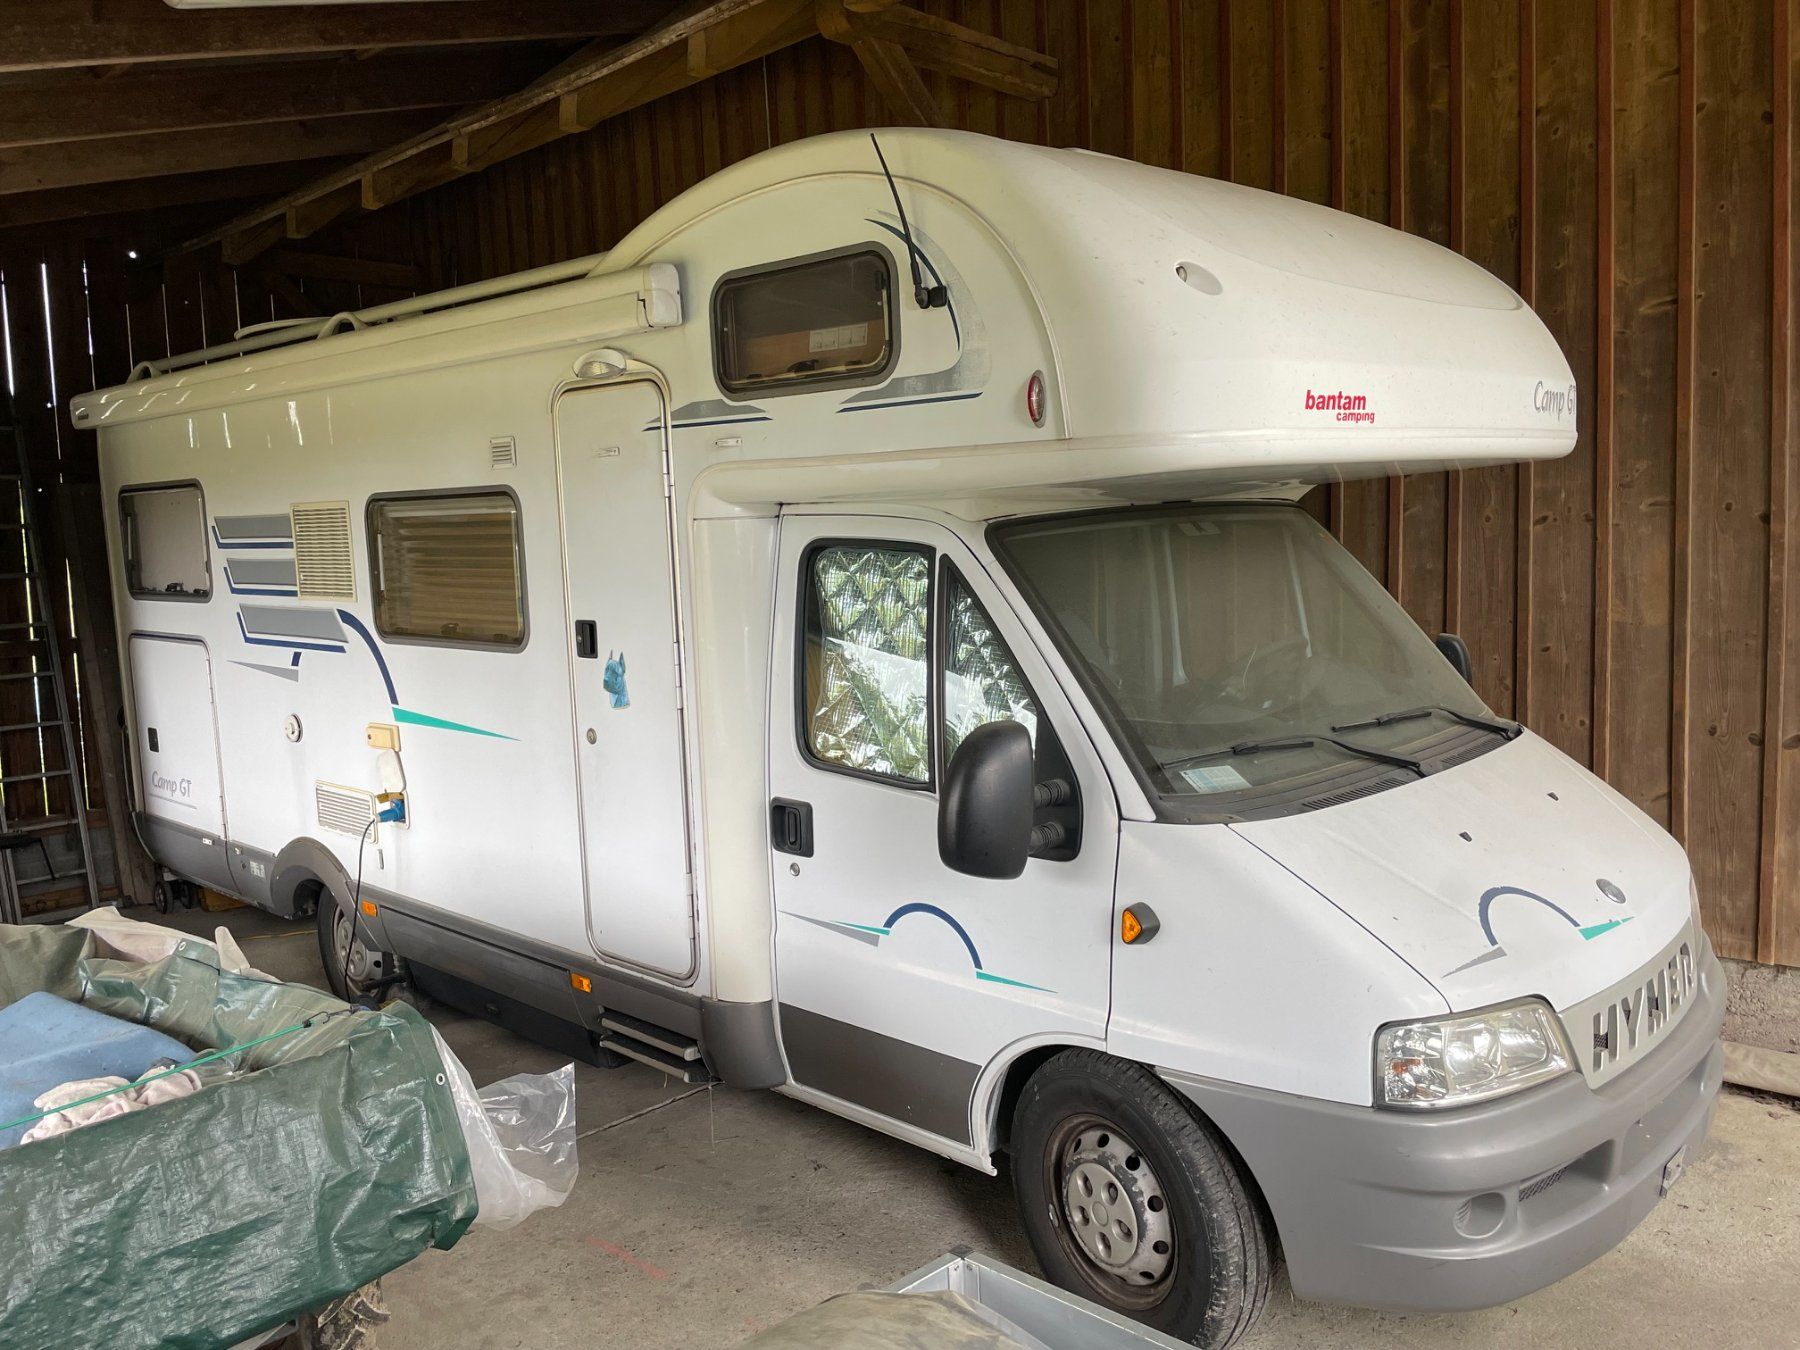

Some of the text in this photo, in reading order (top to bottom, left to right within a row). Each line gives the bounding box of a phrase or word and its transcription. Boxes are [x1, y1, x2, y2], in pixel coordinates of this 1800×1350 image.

[1305, 390, 1366, 410] bantam
[1534, 380, 1565, 422] Camp
[1336, 411, 1375, 424] camping
[152, 771, 192, 798] Camp GT
[1592, 942, 1695, 1073] HYMER
